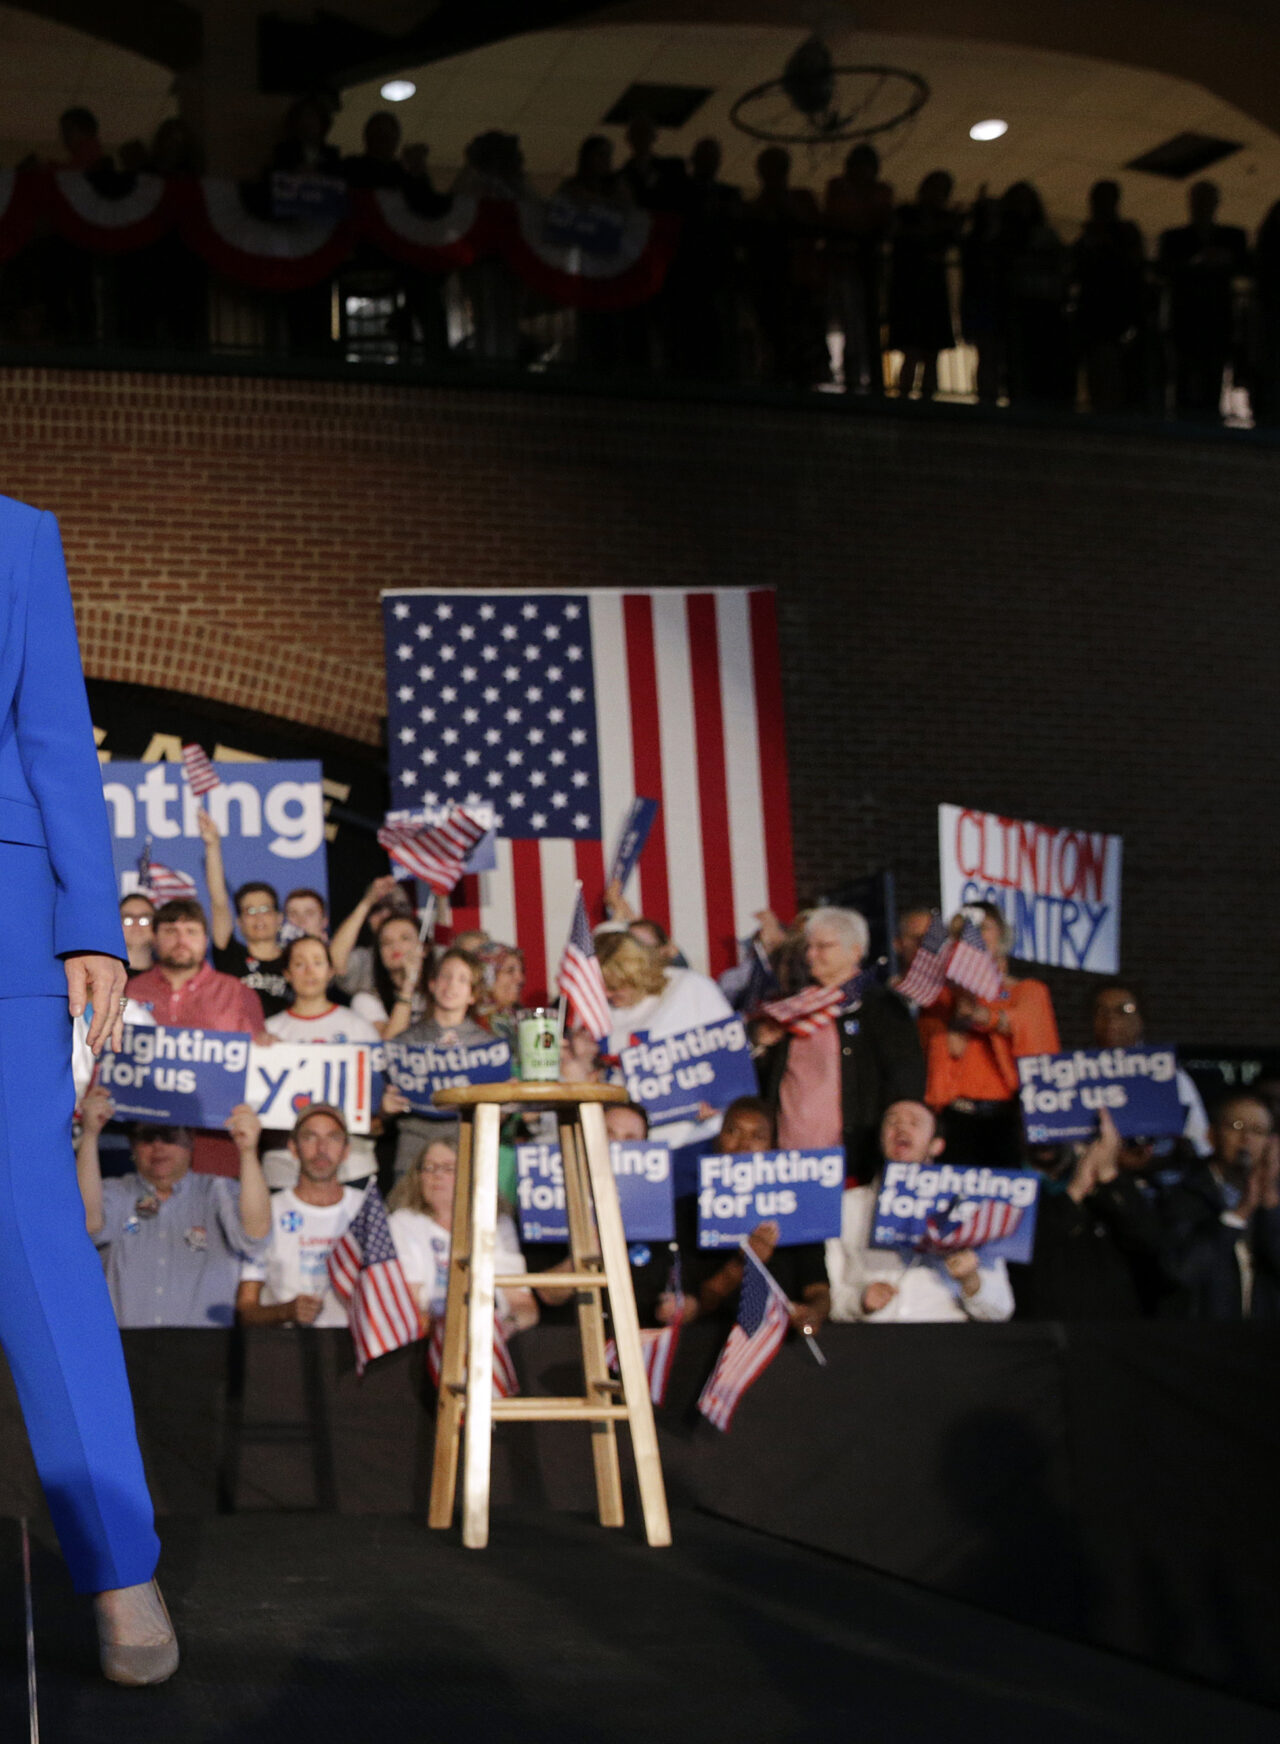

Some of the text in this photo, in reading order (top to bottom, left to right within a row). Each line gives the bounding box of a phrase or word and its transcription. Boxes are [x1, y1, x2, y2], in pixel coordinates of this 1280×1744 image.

[956, 809, 1107, 903] CLINTON
[384, 1041, 510, 1077] Fighting
[620, 1019, 748, 1075] Fighting
[101, 1053, 196, 1094] for us
[388, 1063, 429, 1093] for
[627, 1061, 715, 1102] for us
[1018, 1048, 1175, 1088] Fighting
[1020, 1083, 1128, 1114] for us
[700, 1150, 843, 1194] Fighting
[885, 1163, 1038, 1208] Fighting
[698, 1187, 797, 1219] for us
[879, 1188, 935, 1219] for
